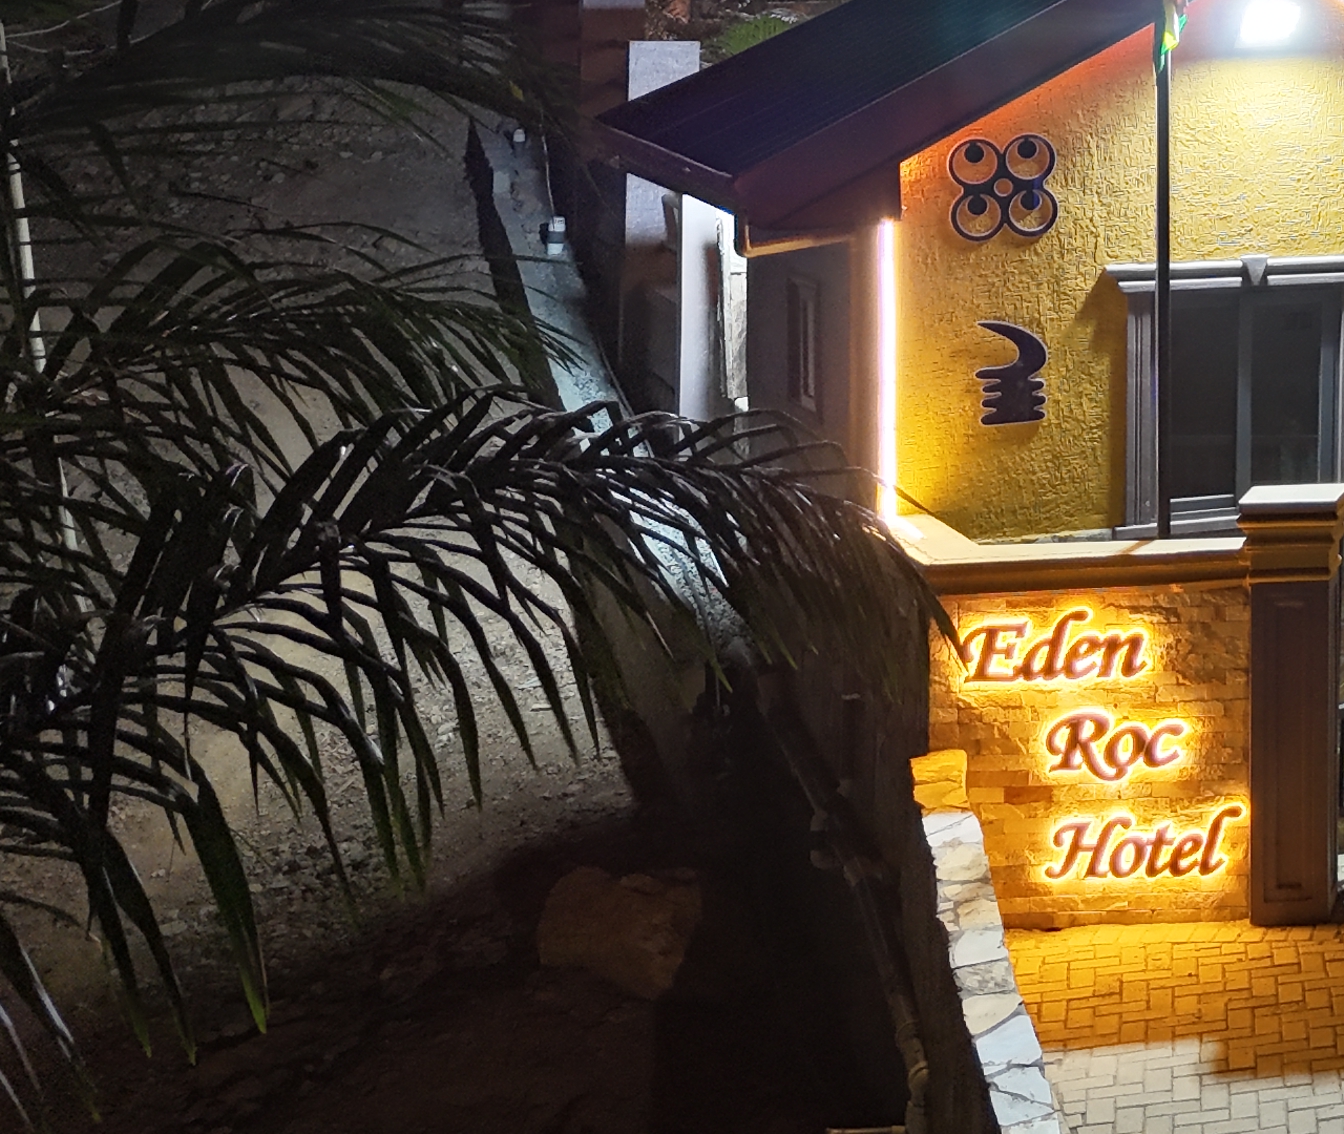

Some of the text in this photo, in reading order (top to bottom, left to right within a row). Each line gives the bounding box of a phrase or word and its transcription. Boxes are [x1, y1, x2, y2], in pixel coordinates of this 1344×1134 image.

[961, 608, 1148, 684] Eden
[1045, 712, 1185, 781] Roc
[1044, 805, 1244, 879] Hotel
